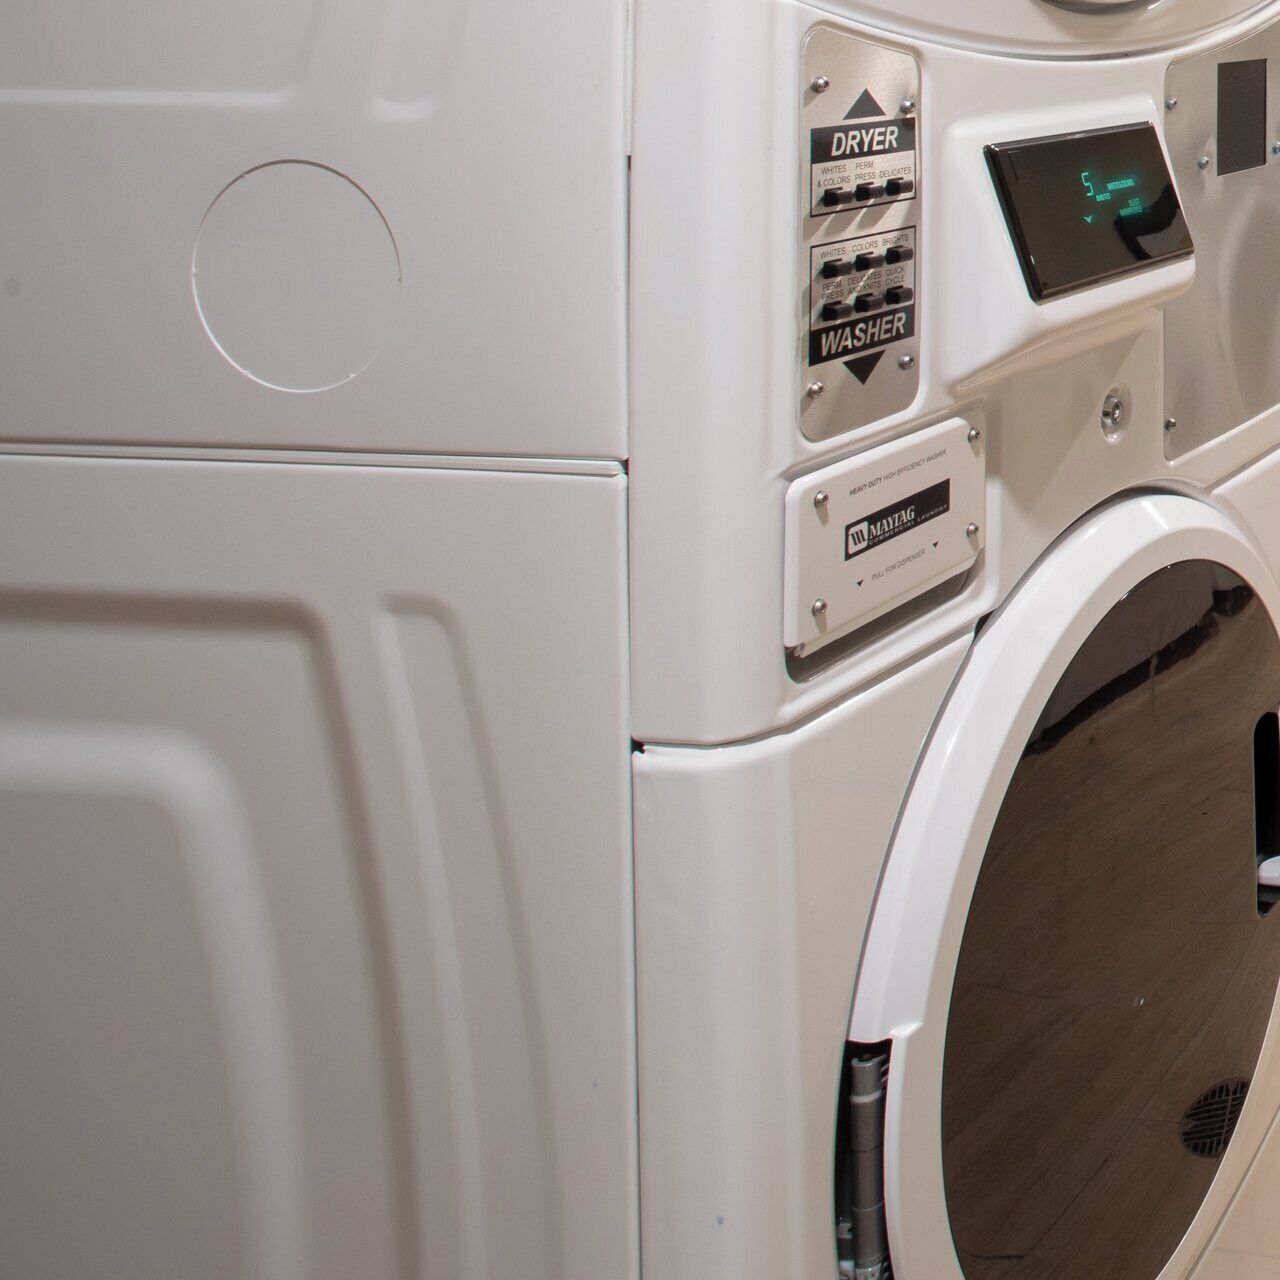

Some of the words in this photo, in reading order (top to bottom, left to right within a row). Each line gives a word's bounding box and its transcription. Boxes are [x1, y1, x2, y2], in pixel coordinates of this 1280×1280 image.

[831, 126, 899, 157] DRYER
[821, 164, 847, 175] WHITES
[855, 160, 874, 170] PERM
[854, 172, 876, 182] PRESS
[879, 166, 912, 178] DELICATES
[823, 175, 851, 187] COLORS
[852, 240, 878, 252] COLORS
[882, 234, 909, 247] BRIGHTS
[820, 247, 846, 259] WHITES
[886, 266, 905, 277] QUICK
[863, 281, 882, 291] KNITS
[885, 275, 905, 286] CYCLE
[822, 289, 844, 301] PRESS
[821, 312, 906, 357] WASHER
[850, 484, 867, 496] HEAVY
[868, 477, 882, 488] DUTY
[883, 472, 896, 482] HIGH
[896, 459, 925, 476] EFFICIENCY
[926, 449, 947, 462] WASHER
[869, 506, 915, 539] MAYTAG
[869, 521, 915, 545] COMMERCIAL
[917, 504, 948, 521] LAUNDRY
[871, 571, 884, 581] PULL
[885, 563, 896, 574] FOR
[897, 548, 926, 569] DISPENSER
